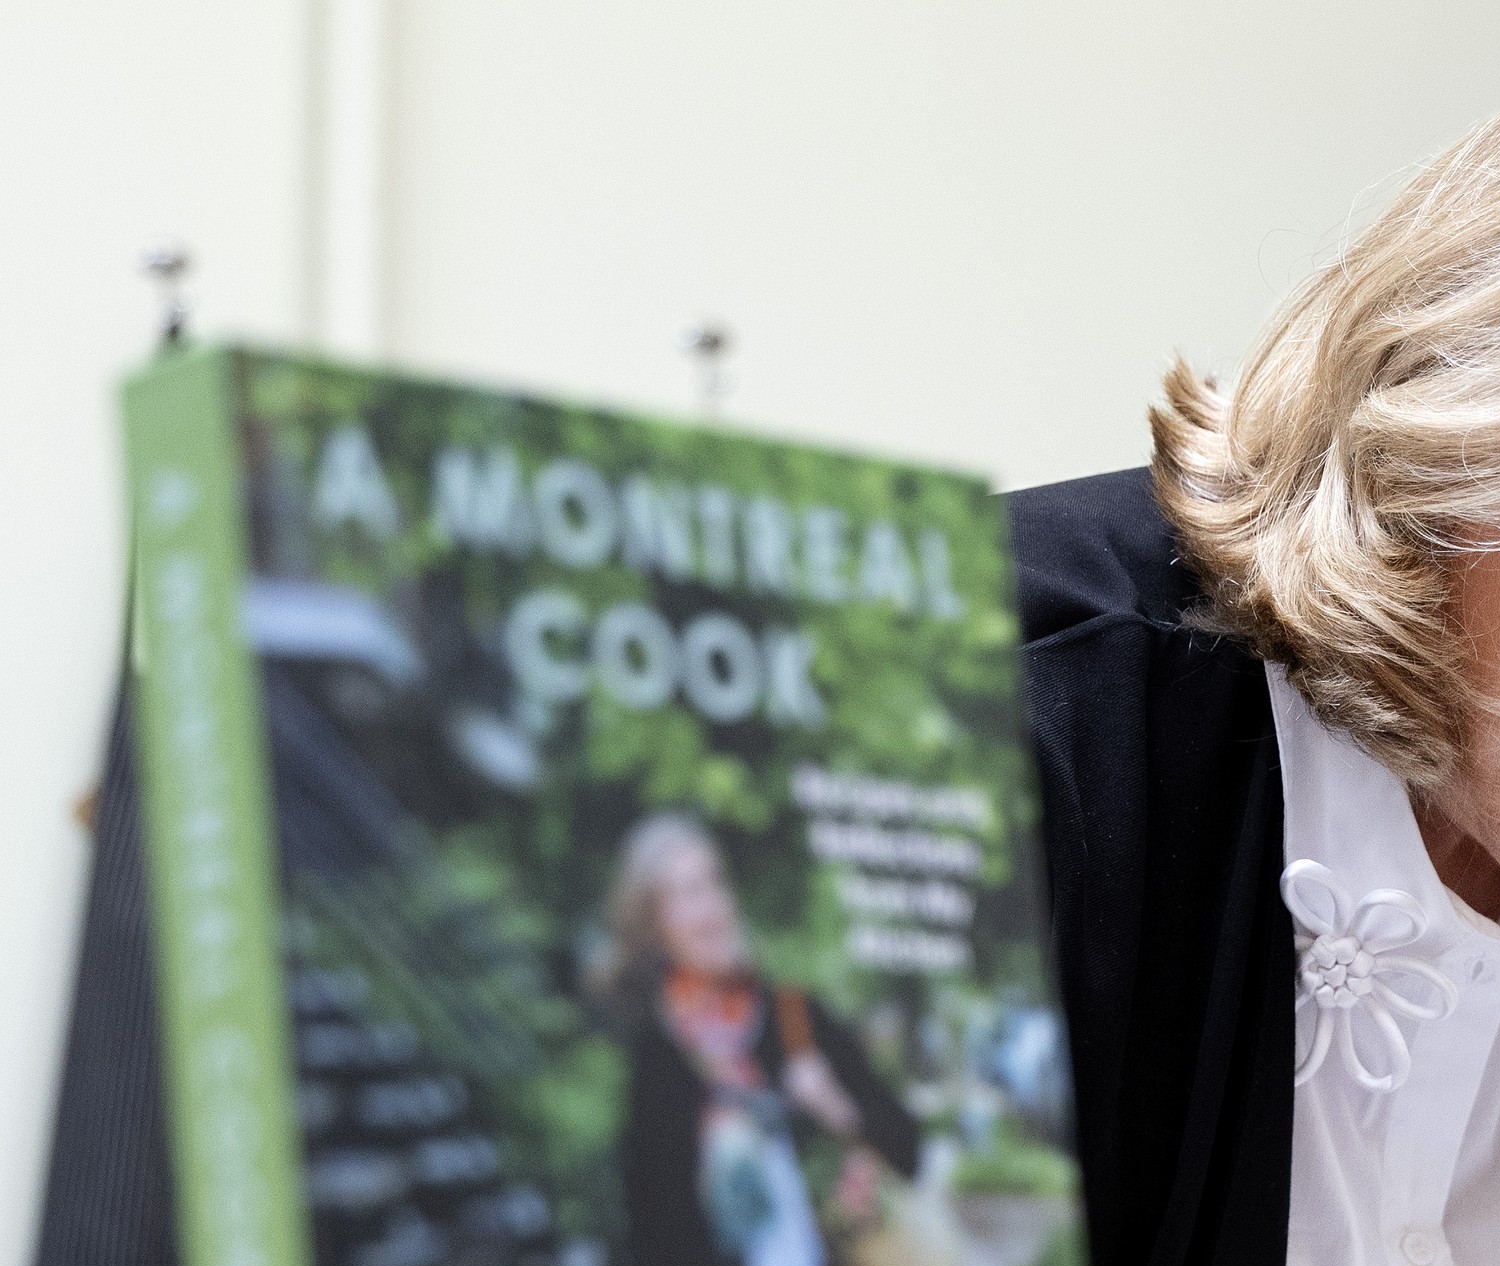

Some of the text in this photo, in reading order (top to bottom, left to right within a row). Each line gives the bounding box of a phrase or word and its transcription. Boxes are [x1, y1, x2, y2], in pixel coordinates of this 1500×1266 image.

[315, 424, 967, 622] A MONTREAL
[507, 586, 828, 726] COOK
